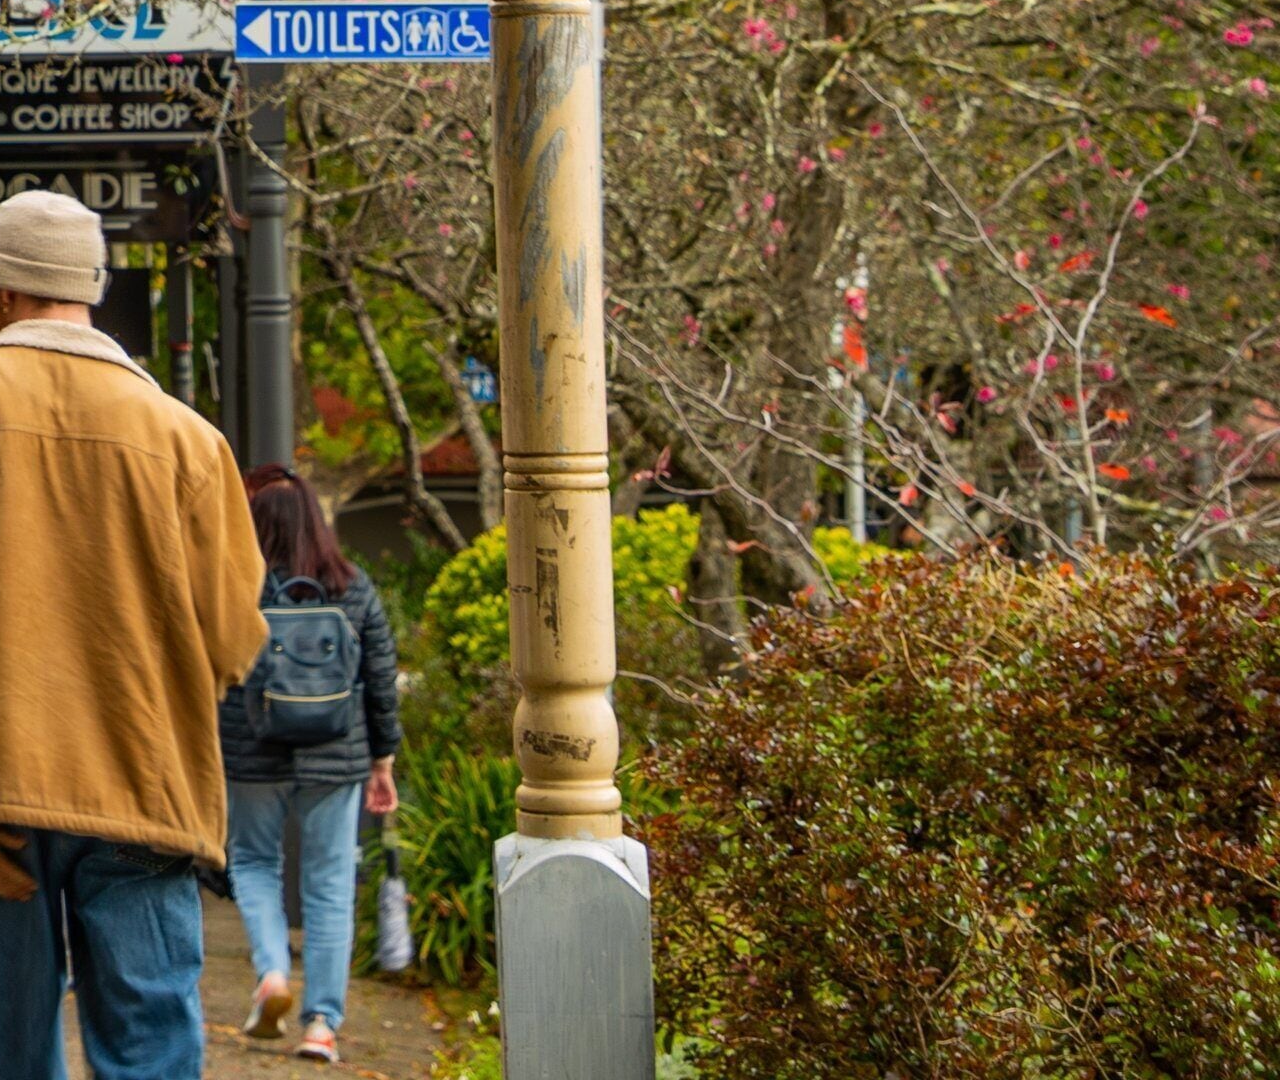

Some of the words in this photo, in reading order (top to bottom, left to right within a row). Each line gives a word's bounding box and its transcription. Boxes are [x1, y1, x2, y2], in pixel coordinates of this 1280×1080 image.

[277, 9, 401, 53] TOILETS
[67, 66, 199, 93] JEWELLERY
[12, 104, 112, 130] COFFEE
[120, 103, 191, 129] SHOP
